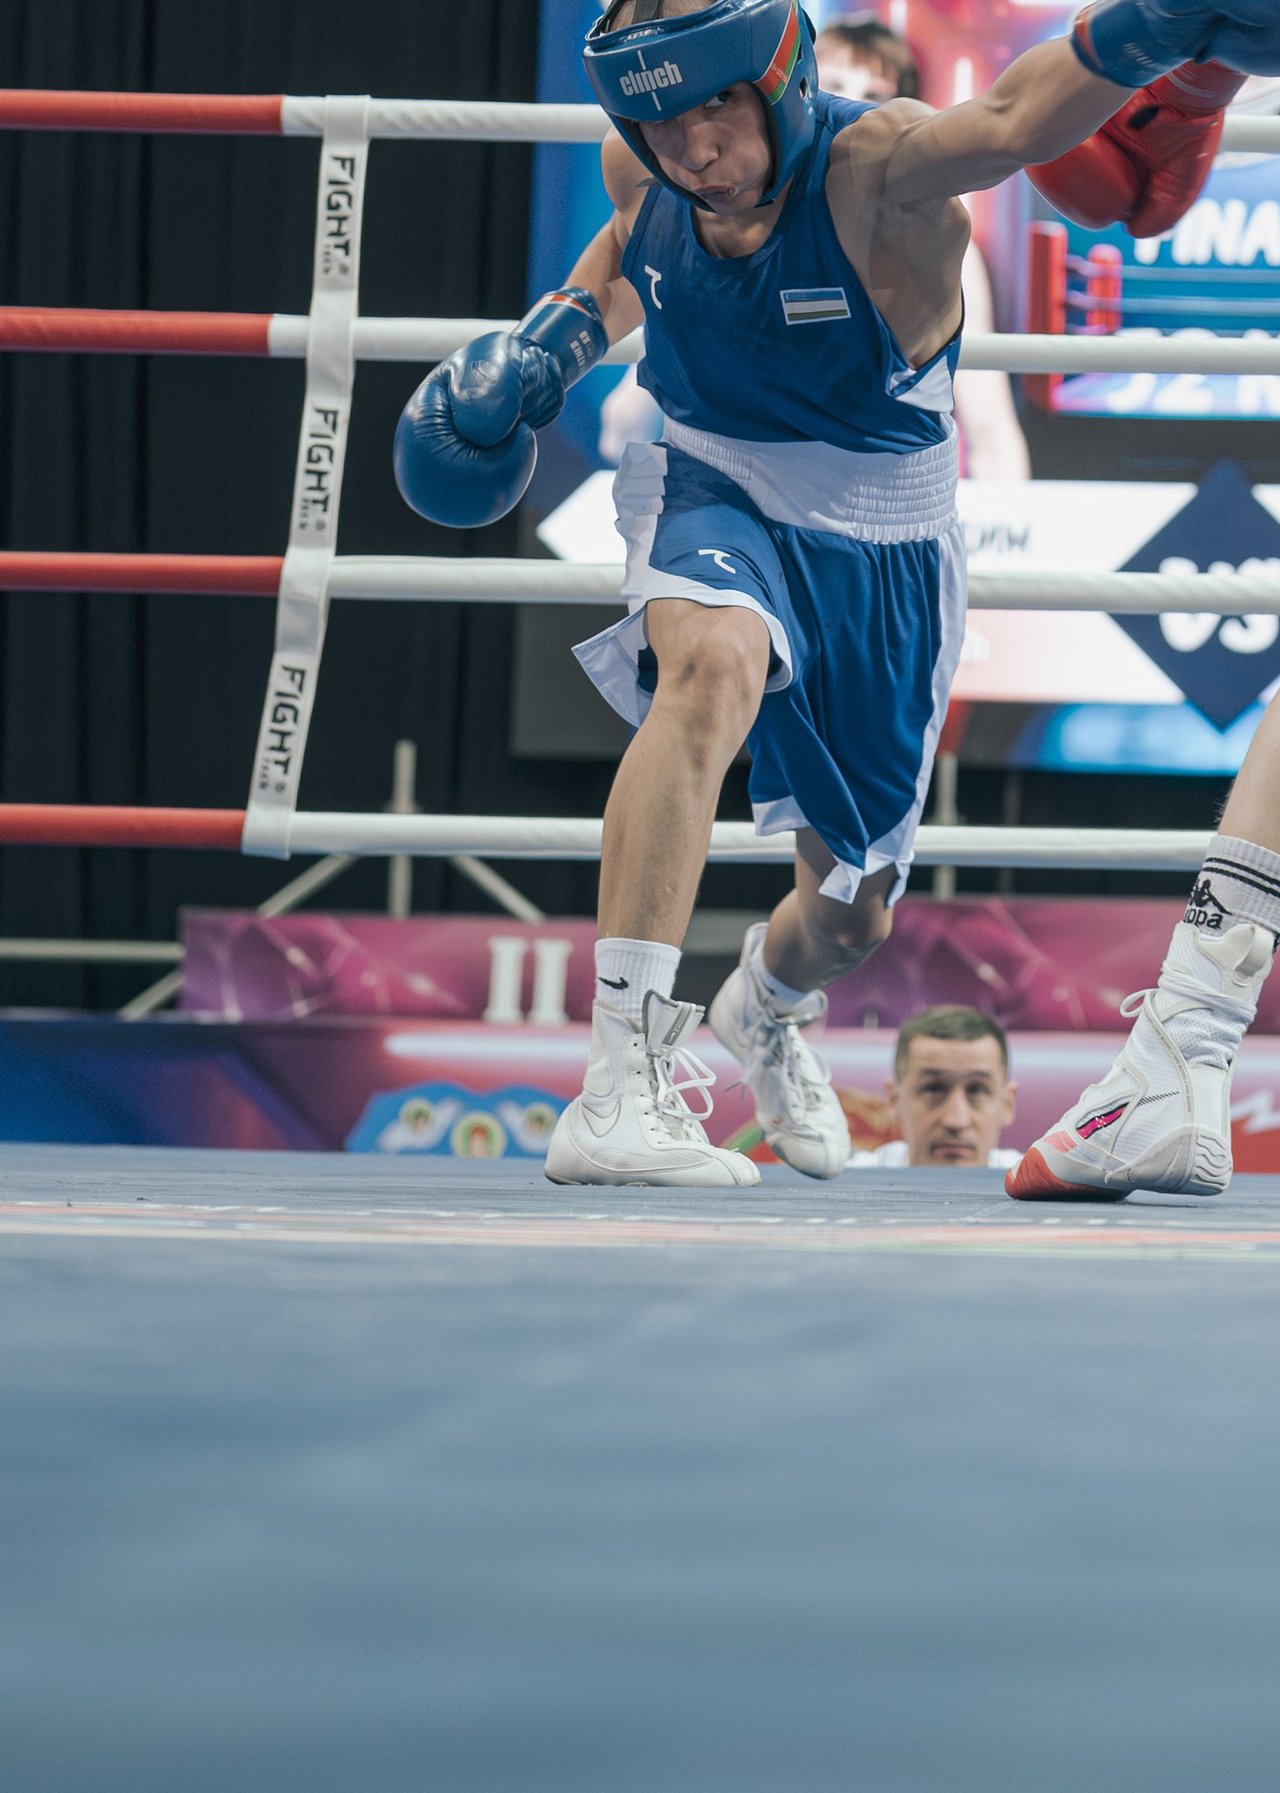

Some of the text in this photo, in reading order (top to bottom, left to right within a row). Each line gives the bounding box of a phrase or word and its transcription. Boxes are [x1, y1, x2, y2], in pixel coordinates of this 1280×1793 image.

[619, 60, 684, 97] clinch
[326, 155, 356, 257] FIGHT
[304, 406, 340, 514] FIGHT
[269, 663, 307, 777] FIGHT
